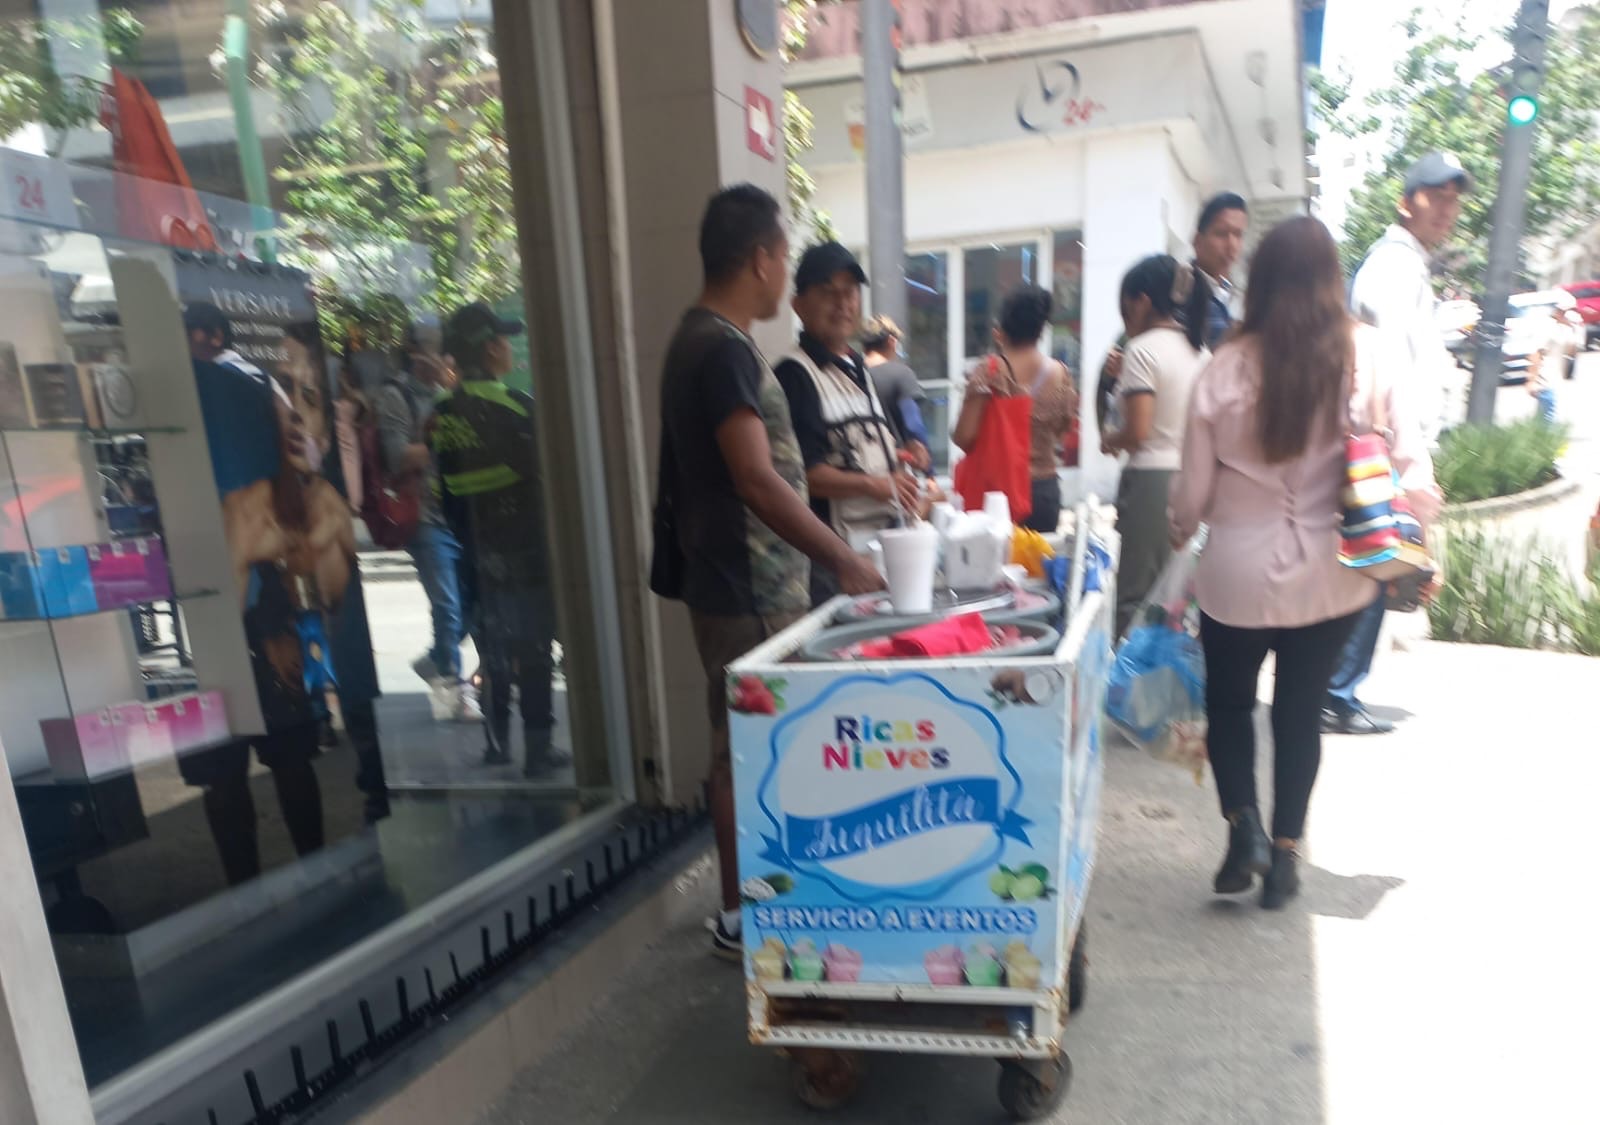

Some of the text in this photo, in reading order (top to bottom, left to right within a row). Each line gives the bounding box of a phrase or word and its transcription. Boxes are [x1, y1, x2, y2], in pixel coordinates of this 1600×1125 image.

[15, 174, 47, 210] 24
[834, 715, 936, 743] Ricas
[822, 744, 951, 770] Nieves
[754, 906, 1037, 933] SERVICIO A EVENTOS
